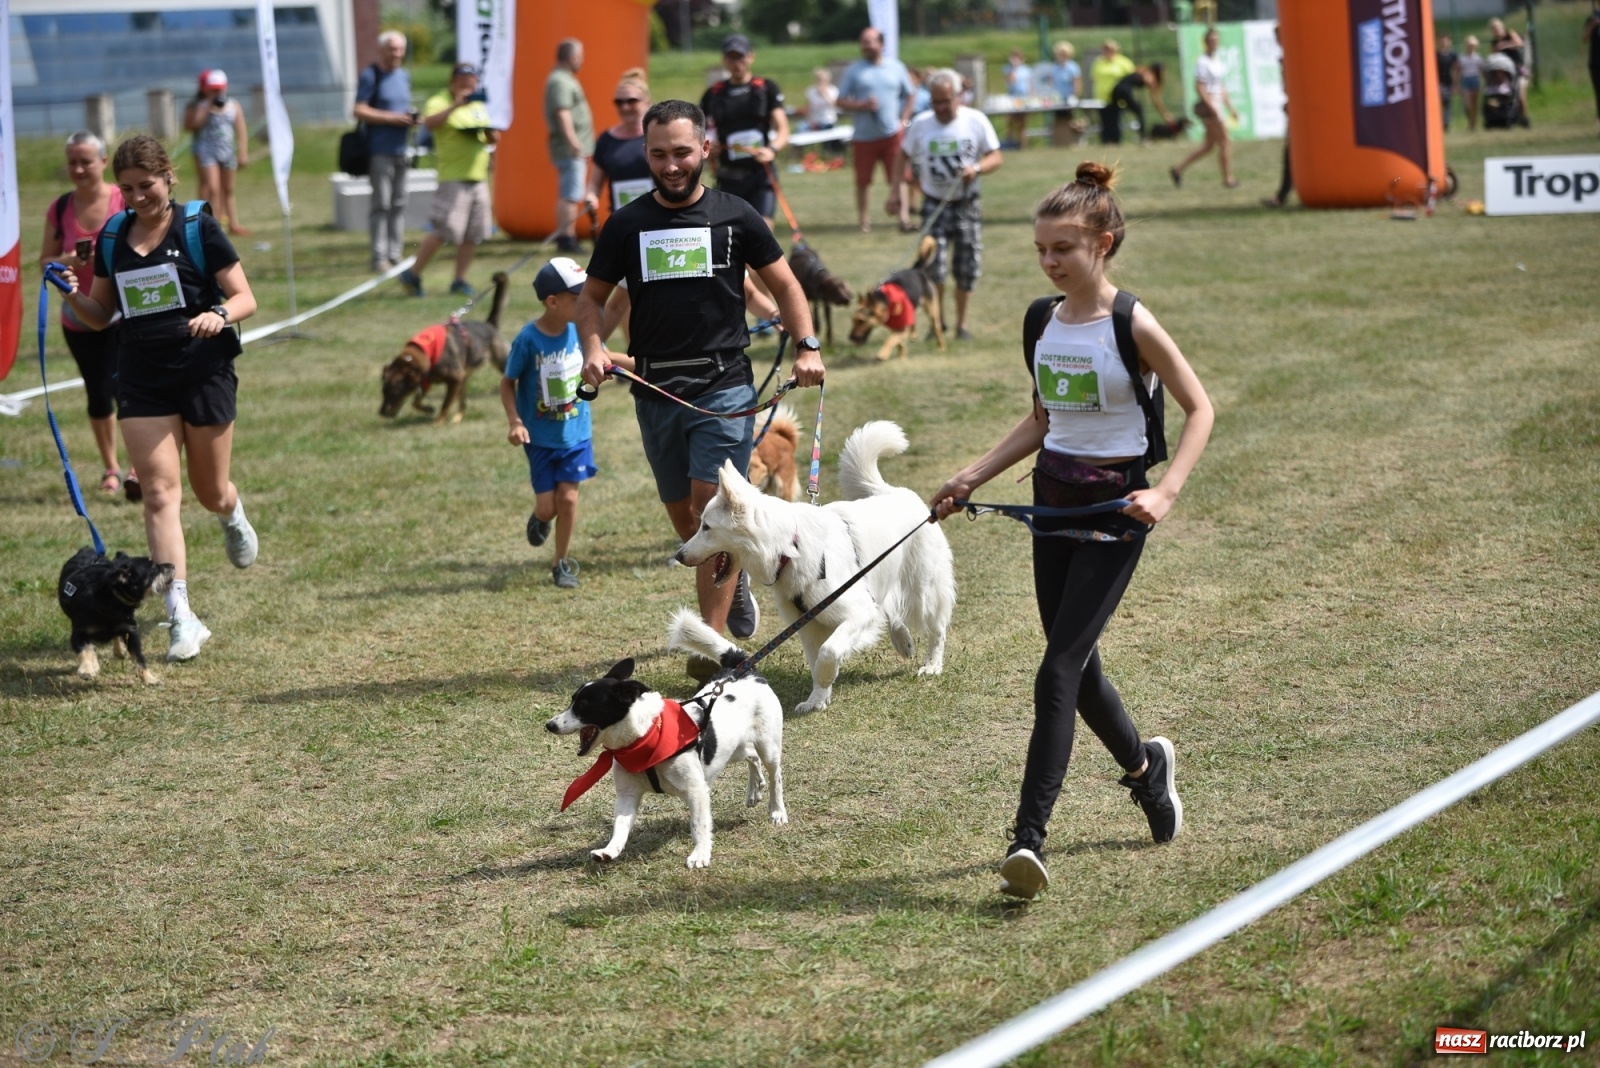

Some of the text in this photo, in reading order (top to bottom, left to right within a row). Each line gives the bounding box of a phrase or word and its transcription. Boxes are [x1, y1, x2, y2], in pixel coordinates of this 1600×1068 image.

[649, 236, 702, 246] DOGTREKKING
[667, 254, 687, 269] 14
[125, 272, 170, 286] DOGTREKKING
[142, 290, 161, 305] 26
[1040, 353, 1093, 364] DOGTREKKING
[566, 379, 577, 394] 12
[1055, 377, 1070, 397] 8
